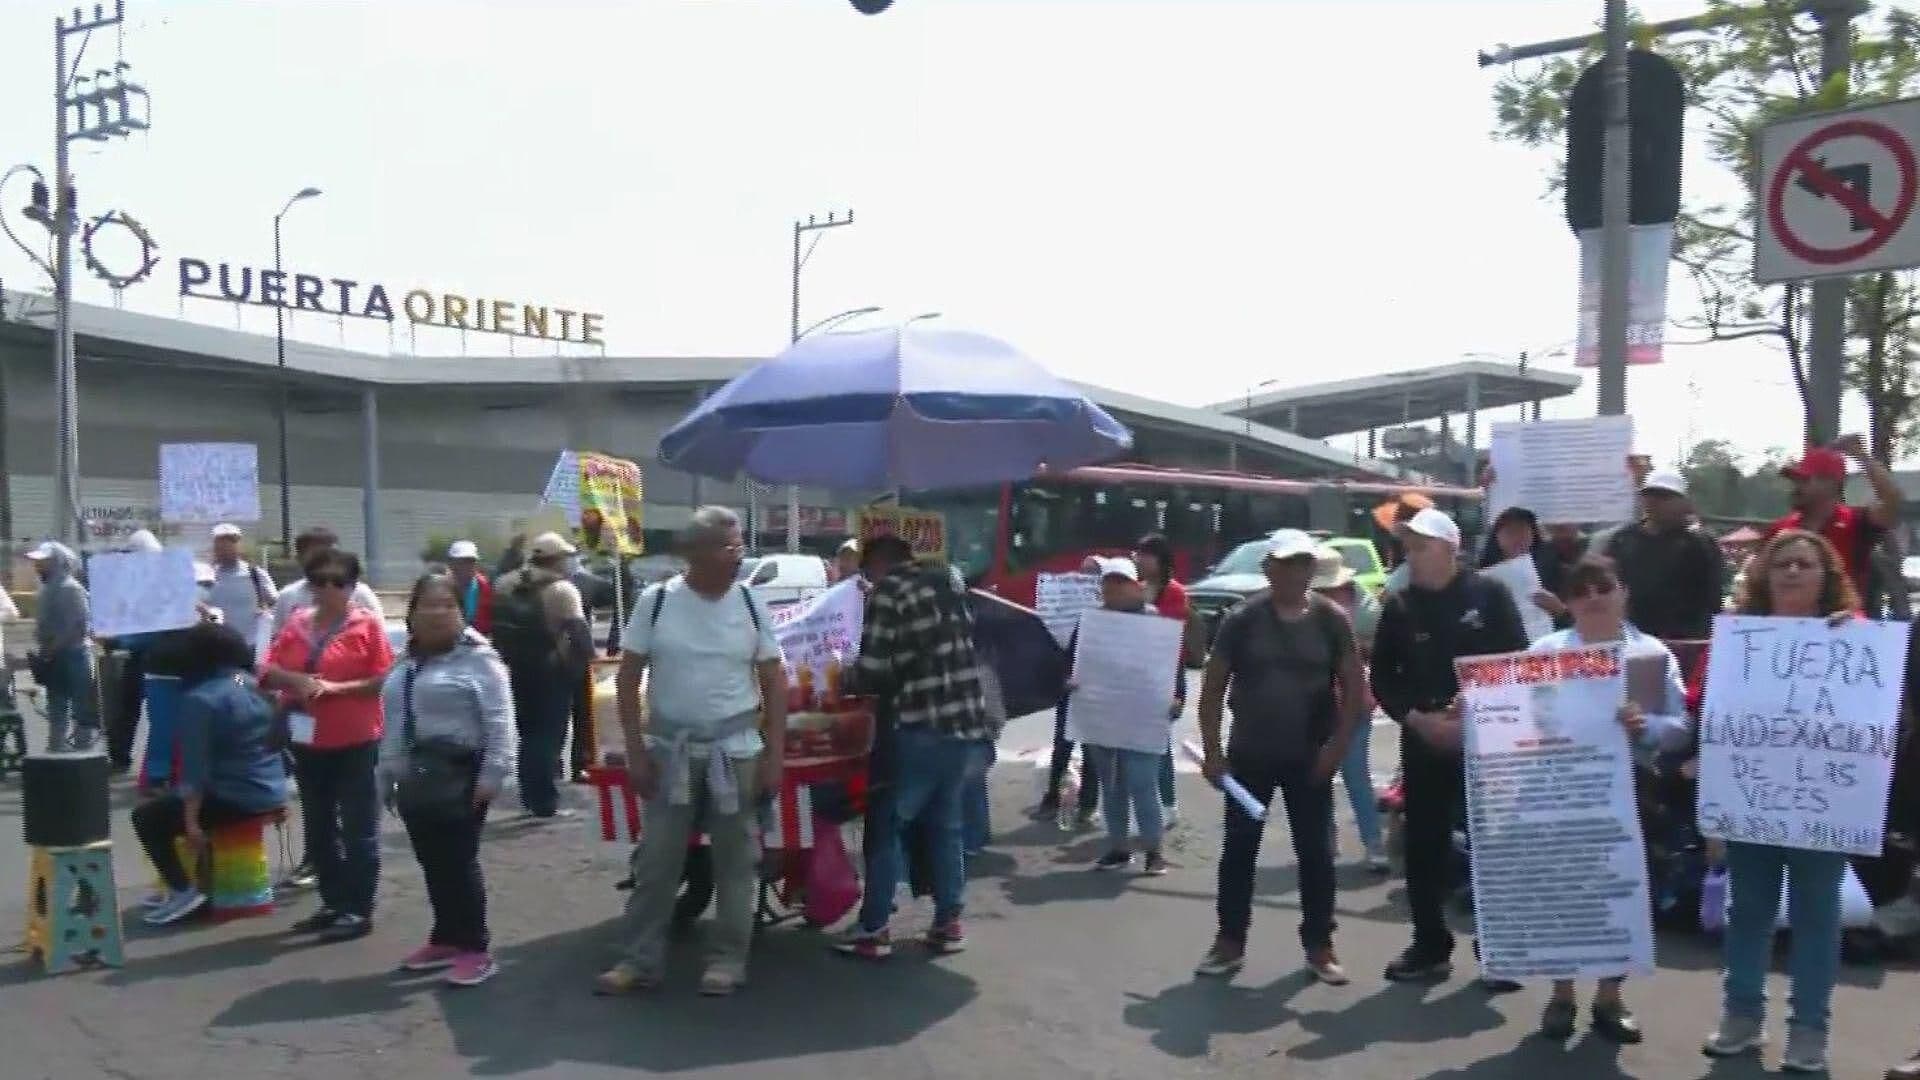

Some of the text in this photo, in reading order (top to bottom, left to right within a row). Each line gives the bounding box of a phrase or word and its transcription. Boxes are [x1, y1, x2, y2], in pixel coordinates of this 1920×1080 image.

[179, 257, 605, 345] PUERTA ORIENTE
[1731, 627, 1885, 688] FUERA
[1783, 681, 1836, 717] LA
[1729, 753, 1858, 787] DE LAS
[1737, 781, 1830, 813] VECES
